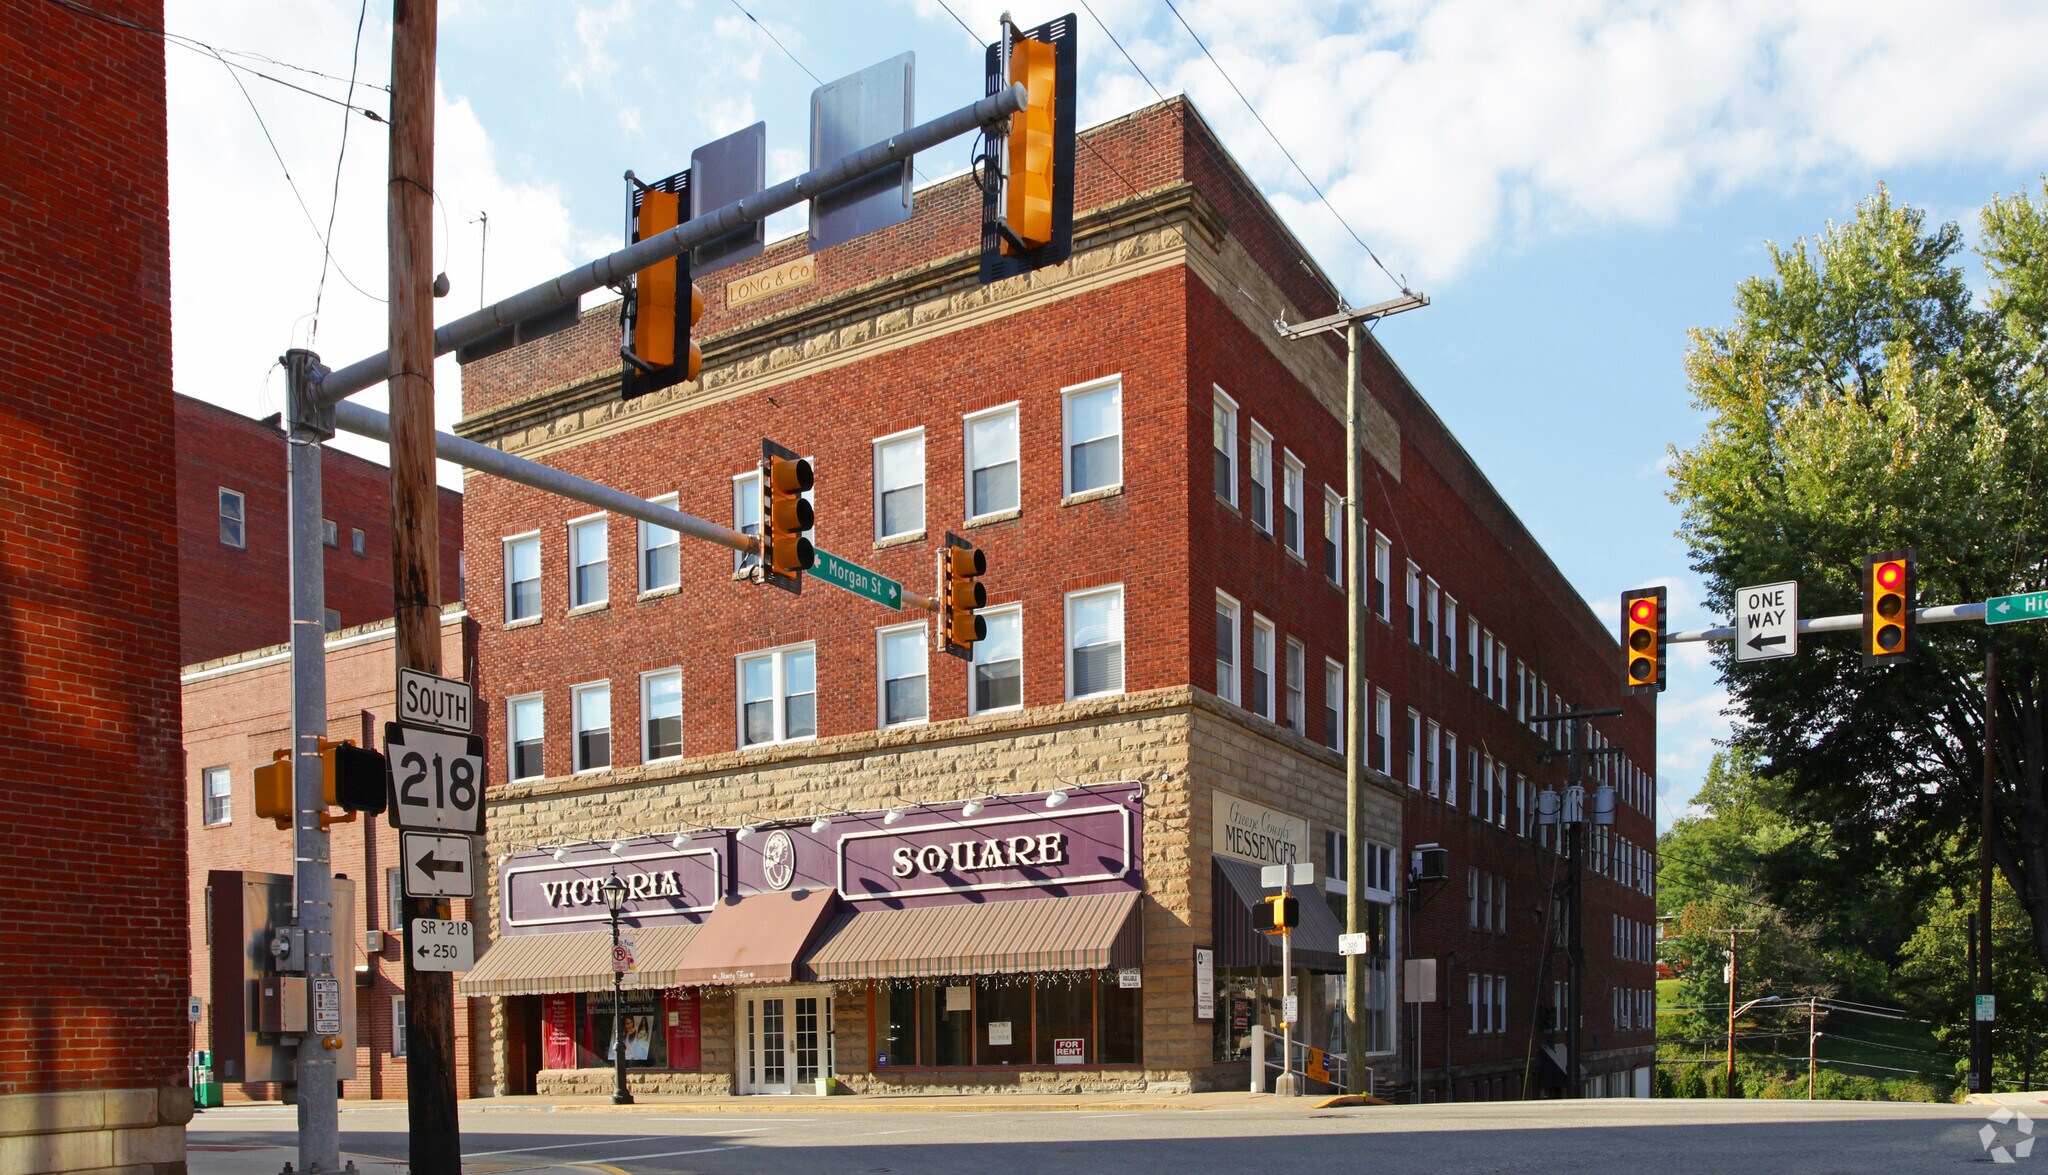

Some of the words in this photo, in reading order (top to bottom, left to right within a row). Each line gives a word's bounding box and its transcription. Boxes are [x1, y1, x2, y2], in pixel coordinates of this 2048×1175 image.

[730, 276, 770, 302] LONG
[775, 270, 785, 286] &
[829, 558, 868, 590] Morgan
[871, 576, 882, 595] St
[1749, 590, 1784, 610] ONE
[1748, 609, 1786, 629] WAY
[406, 680, 467, 723] SOUTH
[400, 751, 476, 812] 218
[1229, 801, 1259, 833] Greene
[892, 832, 1062, 876] SQUARE
[1225, 824, 1297, 865] MESSENGER
[421, 920, 436, 935] SR
[447, 921, 468, 936] 218
[433, 944, 457, 958] 250
